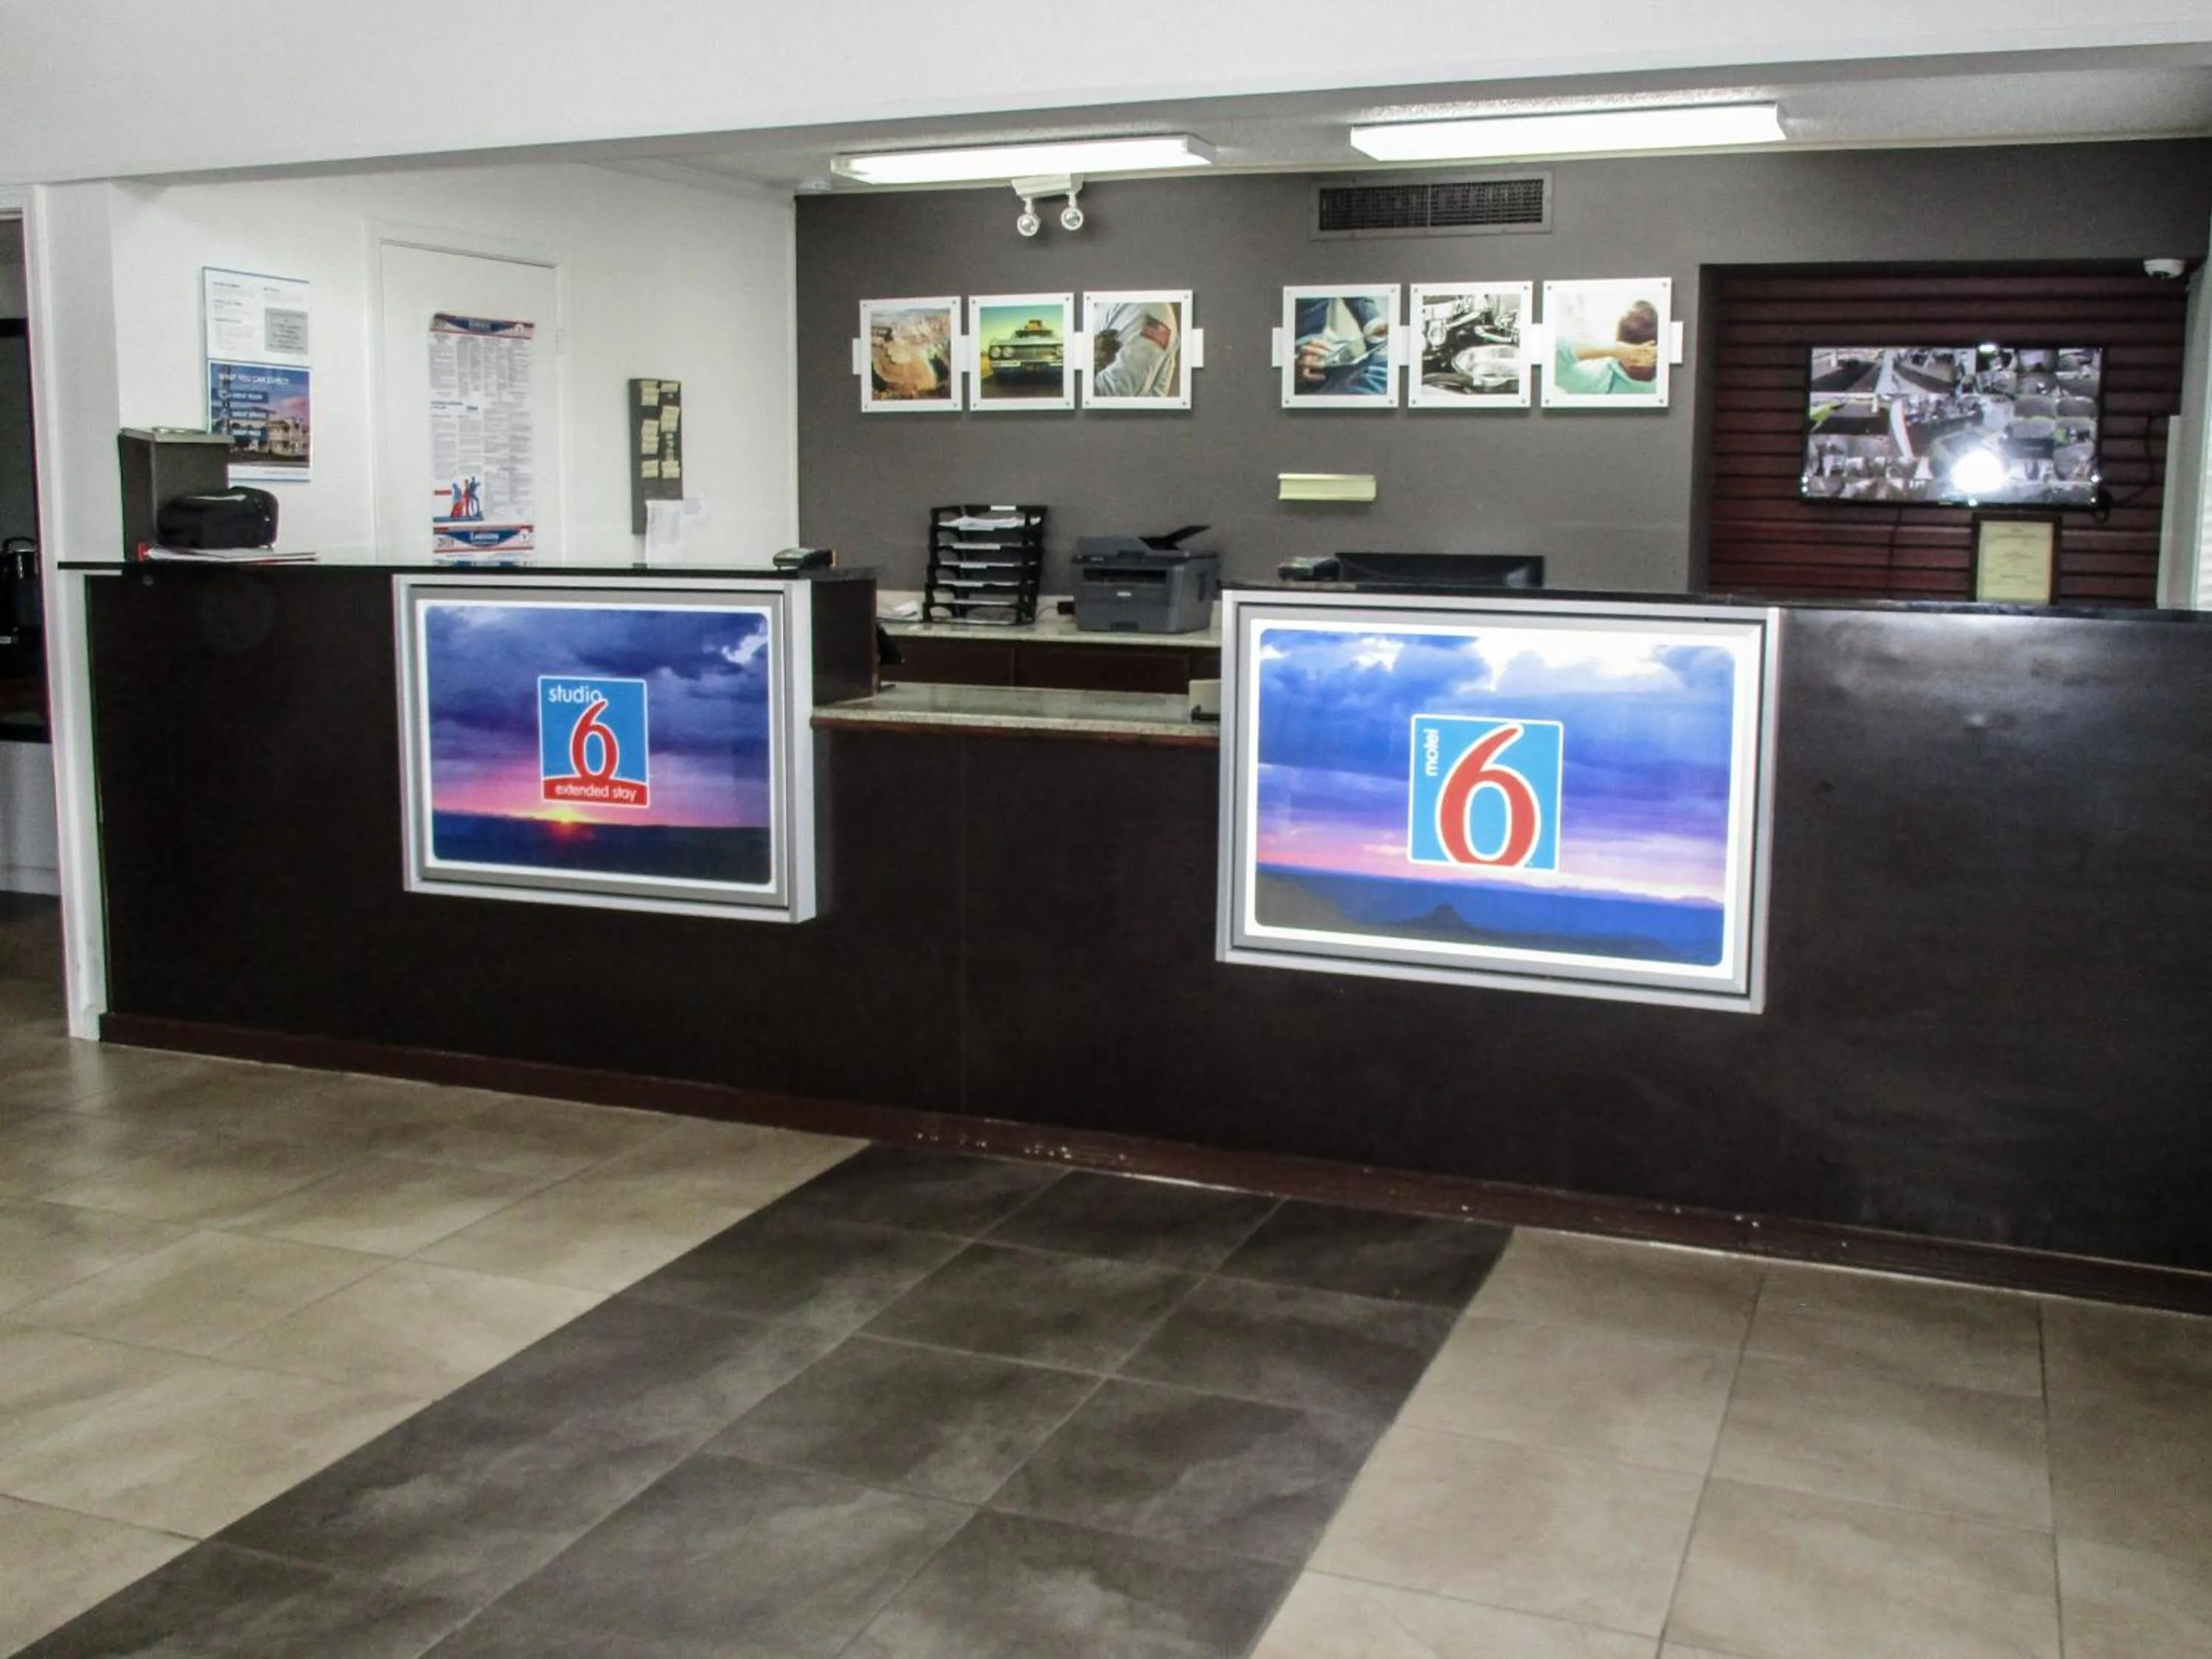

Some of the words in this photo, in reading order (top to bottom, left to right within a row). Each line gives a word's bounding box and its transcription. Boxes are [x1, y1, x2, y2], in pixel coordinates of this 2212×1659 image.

[548, 684, 602, 703] studio
[569, 698, 620, 779] 6
[1422, 728, 1439, 776] motel
[554, 783, 609, 799] extended
[612, 787, 638, 803] stay
[1434, 722, 1542, 868] 6
